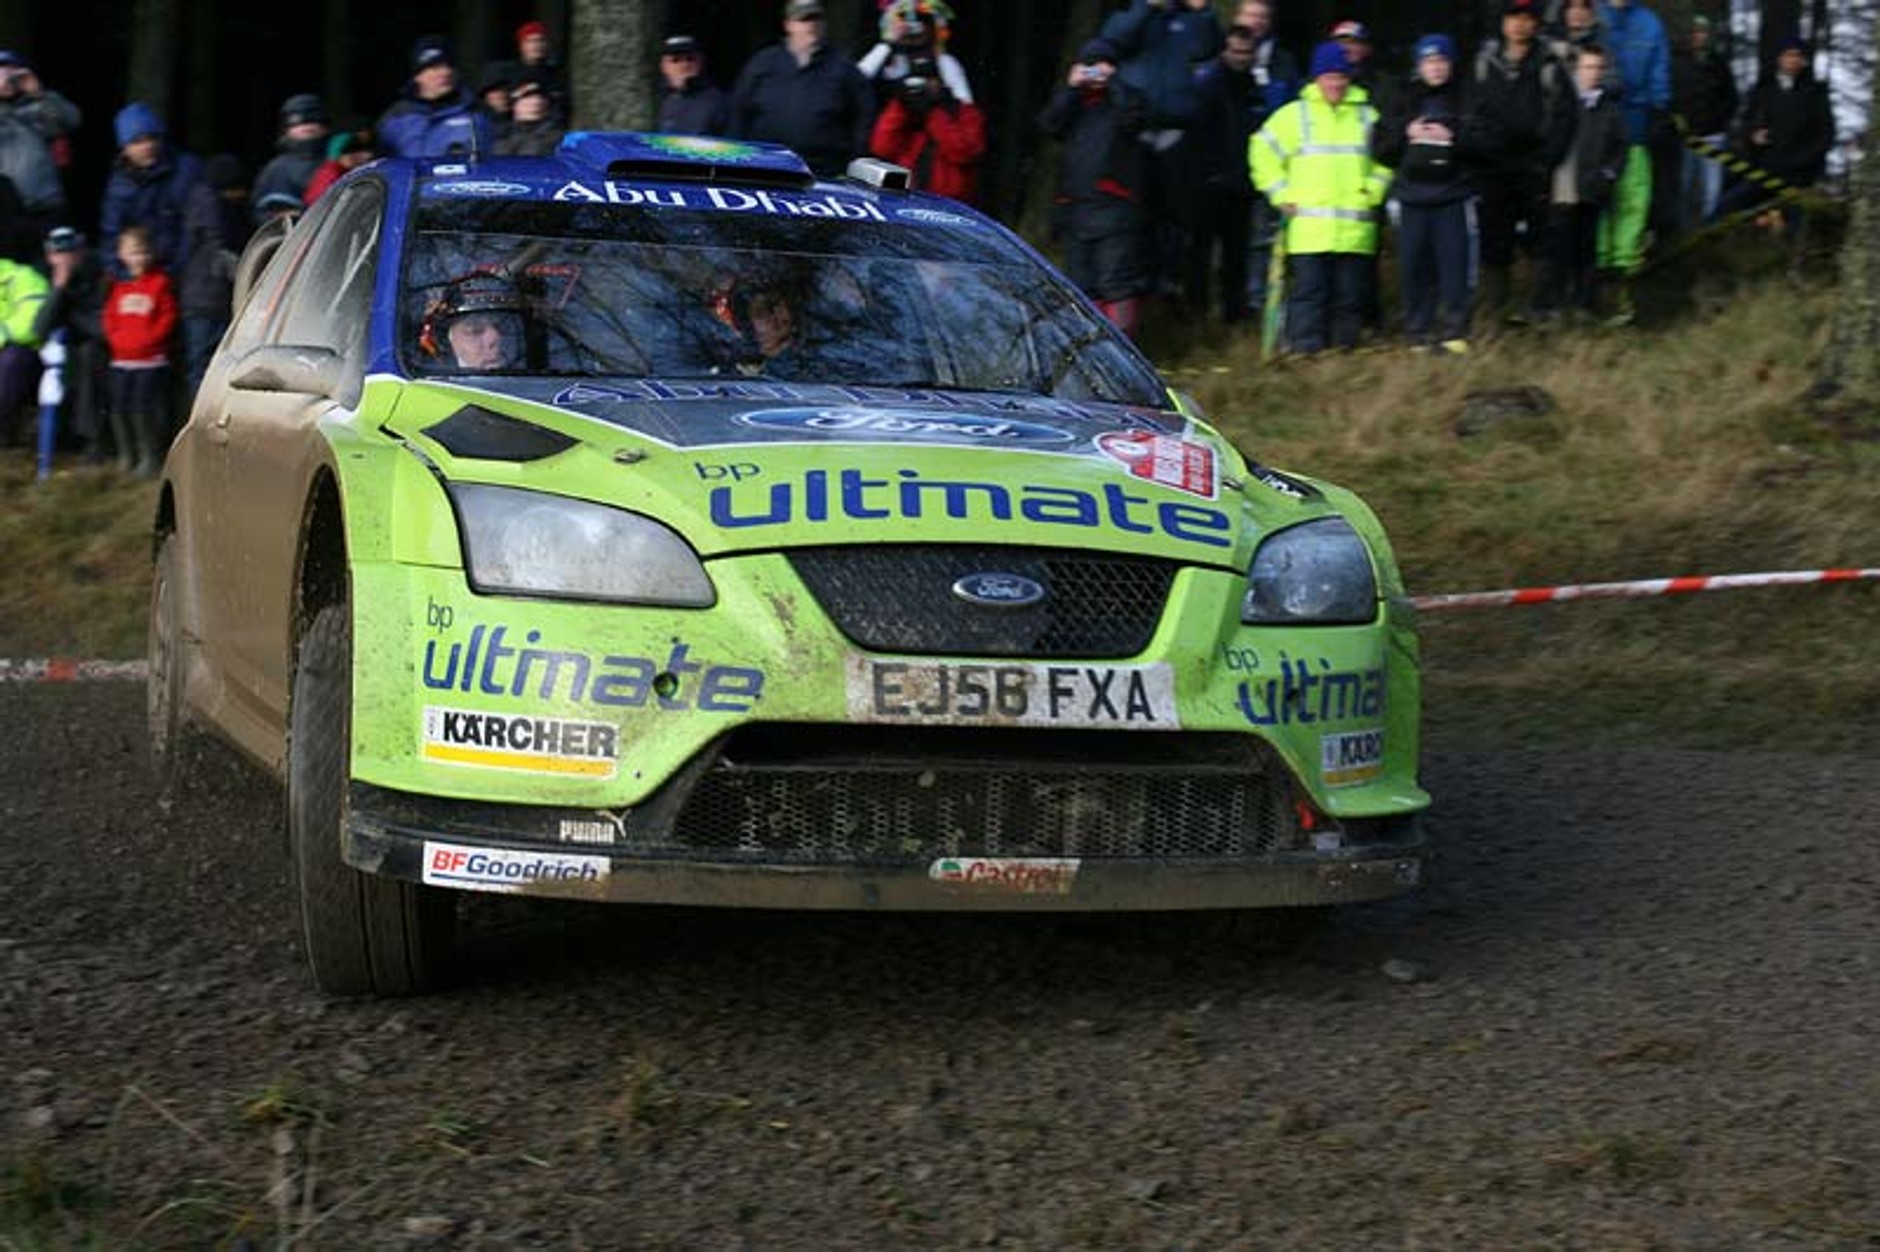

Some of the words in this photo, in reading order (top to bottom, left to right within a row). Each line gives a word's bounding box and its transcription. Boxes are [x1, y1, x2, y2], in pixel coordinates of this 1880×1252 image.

[554, 180, 685, 207] Abu
[805, 410, 1019, 438] Ford
[694, 462, 761, 481] bp
[710, 468, 1231, 548] ultimate
[427, 598, 453, 632] bp
[423, 625, 765, 712] ultimate
[1222, 642, 1259, 675] bp
[1049, 667, 1155, 722] FXA
[443, 711, 618, 758] KÄRCHER
[432, 850, 598, 882] BFGoodrich
